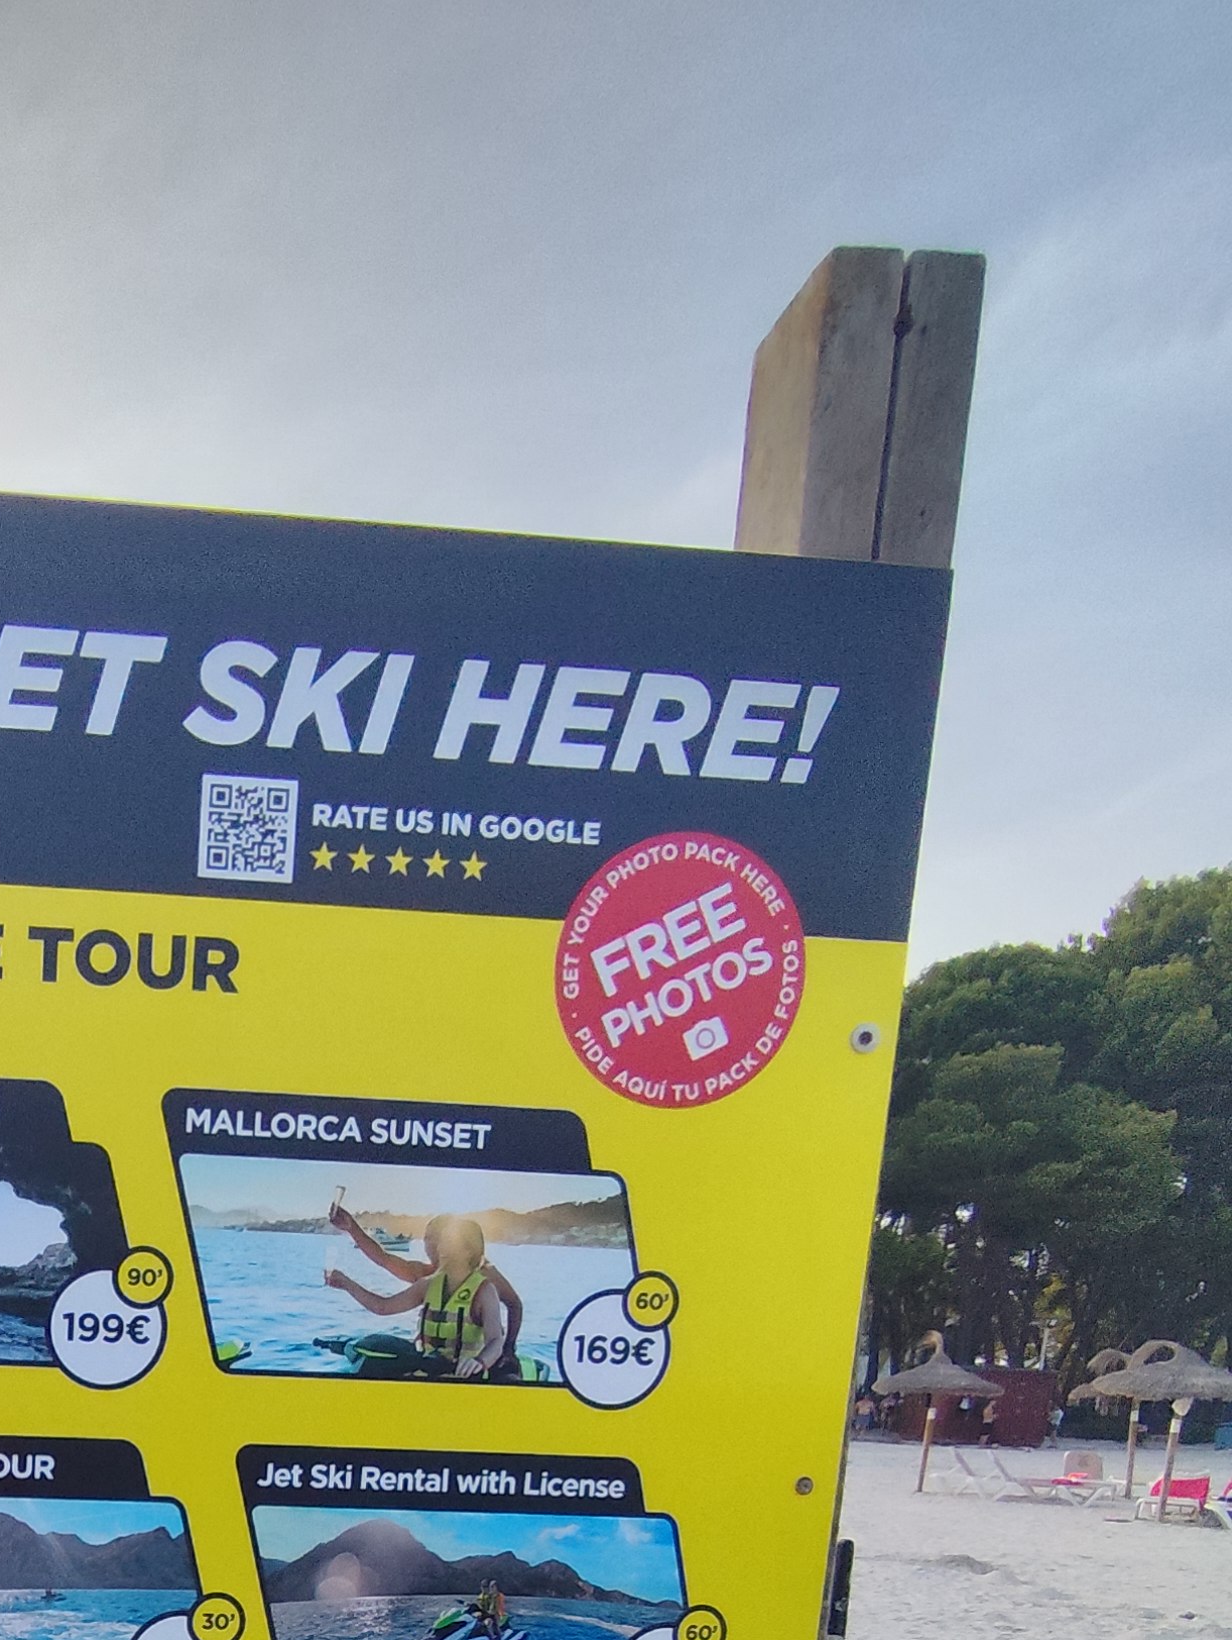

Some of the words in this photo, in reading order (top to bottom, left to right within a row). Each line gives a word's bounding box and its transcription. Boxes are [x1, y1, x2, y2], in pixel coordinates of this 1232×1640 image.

[183, 638, 414, 757] SKI
[433, 658, 841, 784] HERE!
[312, 802, 387, 834] RATE
[394, 807, 435, 836] US
[442, 810, 471, 837] IN
[479, 812, 602, 846] GOOGLE
[605, 842, 679, 889] PHOTO
[683, 841, 741, 873] PACK
[739, 862, 786, 917] HERE
[568, 885, 609, 946] YOUR
[28, 925, 241, 995] TOUR
[590, 881, 746, 998] FREE
[563, 953, 580, 1000] GET
[601, 936, 773, 1049] PHOTOS
[575, 1026, 615, 1076] PIDE
[612, 1068, 667, 1100] AQUÍ
[671, 1082, 700, 1102] TU
[705, 1052, 760, 1096] PACK
[755, 1021, 784, 1056] DE
[773, 938, 800, 1020] FOTOS
[185, 1107, 363, 1144] MALLORCA
[369, 1117, 493, 1151] SUNSET
[61, 1311, 151, 1345] 199€
[572, 1334, 657, 1368] 169€
[256, 1462, 303, 1490] Jet
[308, 1464, 353, 1491] Ski
[359, 1466, 450, 1496] Rental
[455, 1470, 517, 1497] with
[522, 1471, 626, 1500] License
